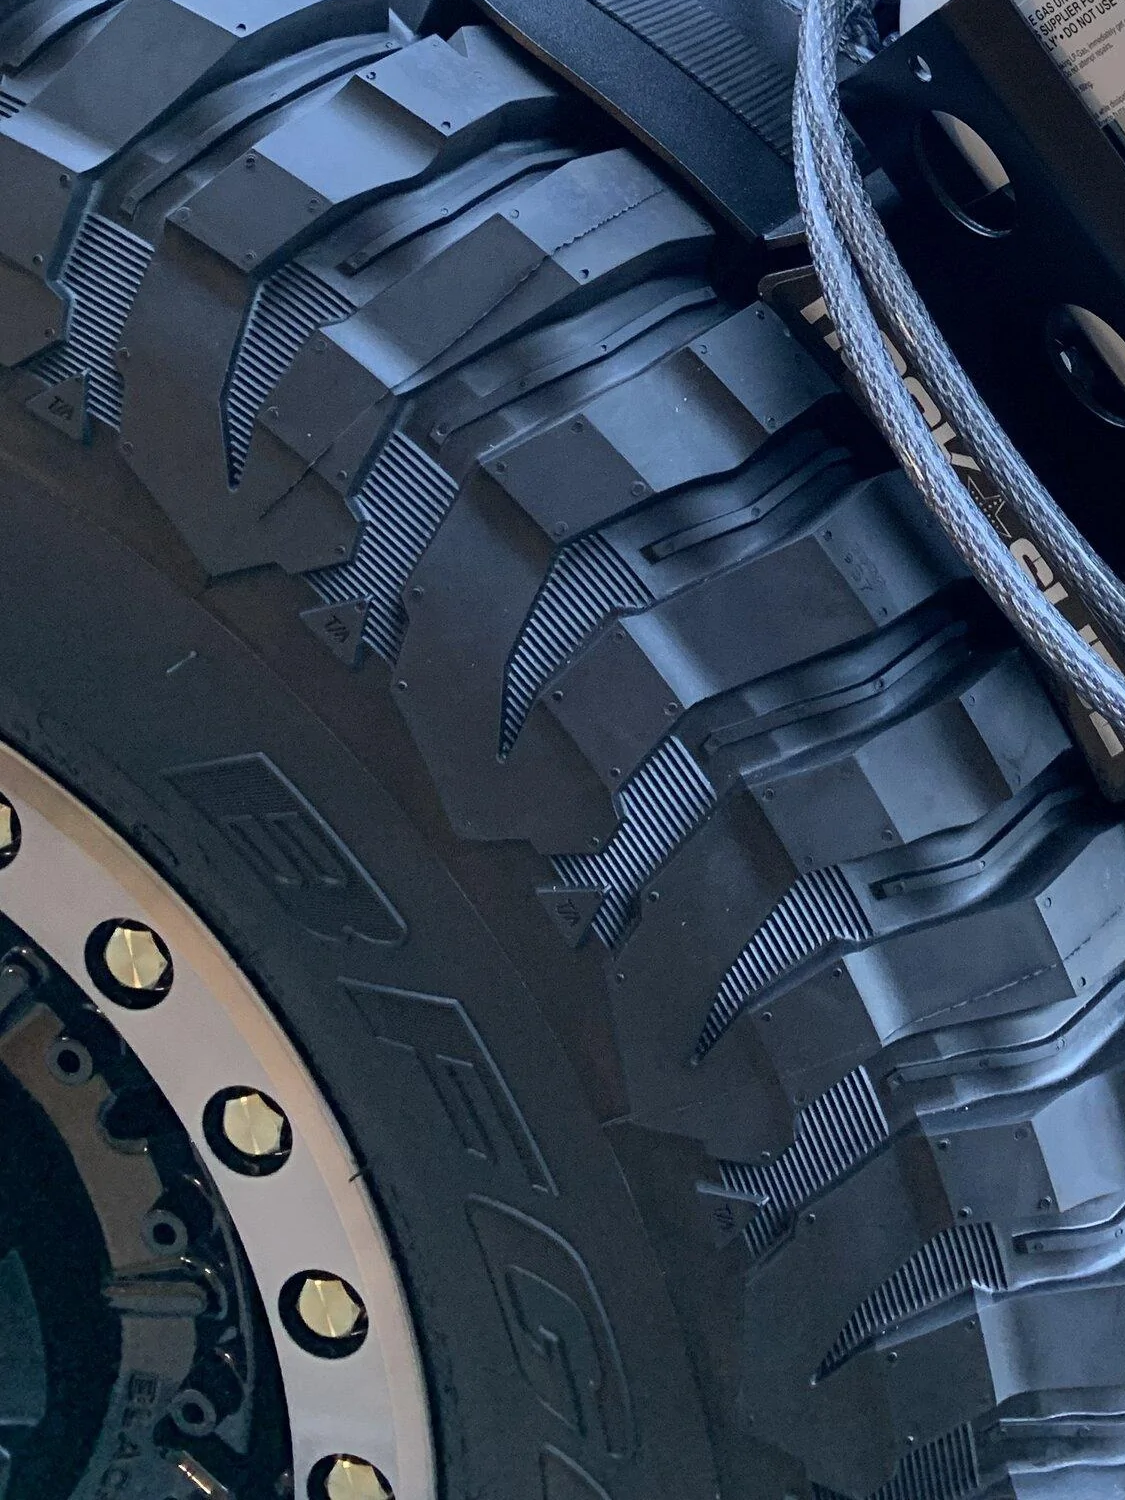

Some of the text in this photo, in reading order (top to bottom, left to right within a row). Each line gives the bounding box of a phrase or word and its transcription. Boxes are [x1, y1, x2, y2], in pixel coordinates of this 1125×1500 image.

[1034, 1, 1055, 21] GAS
[1038, 1, 1082, 36] SUPPLIER
[1062, 21, 1080, 38] DO
[1076, 8, 1098, 29] NOT
